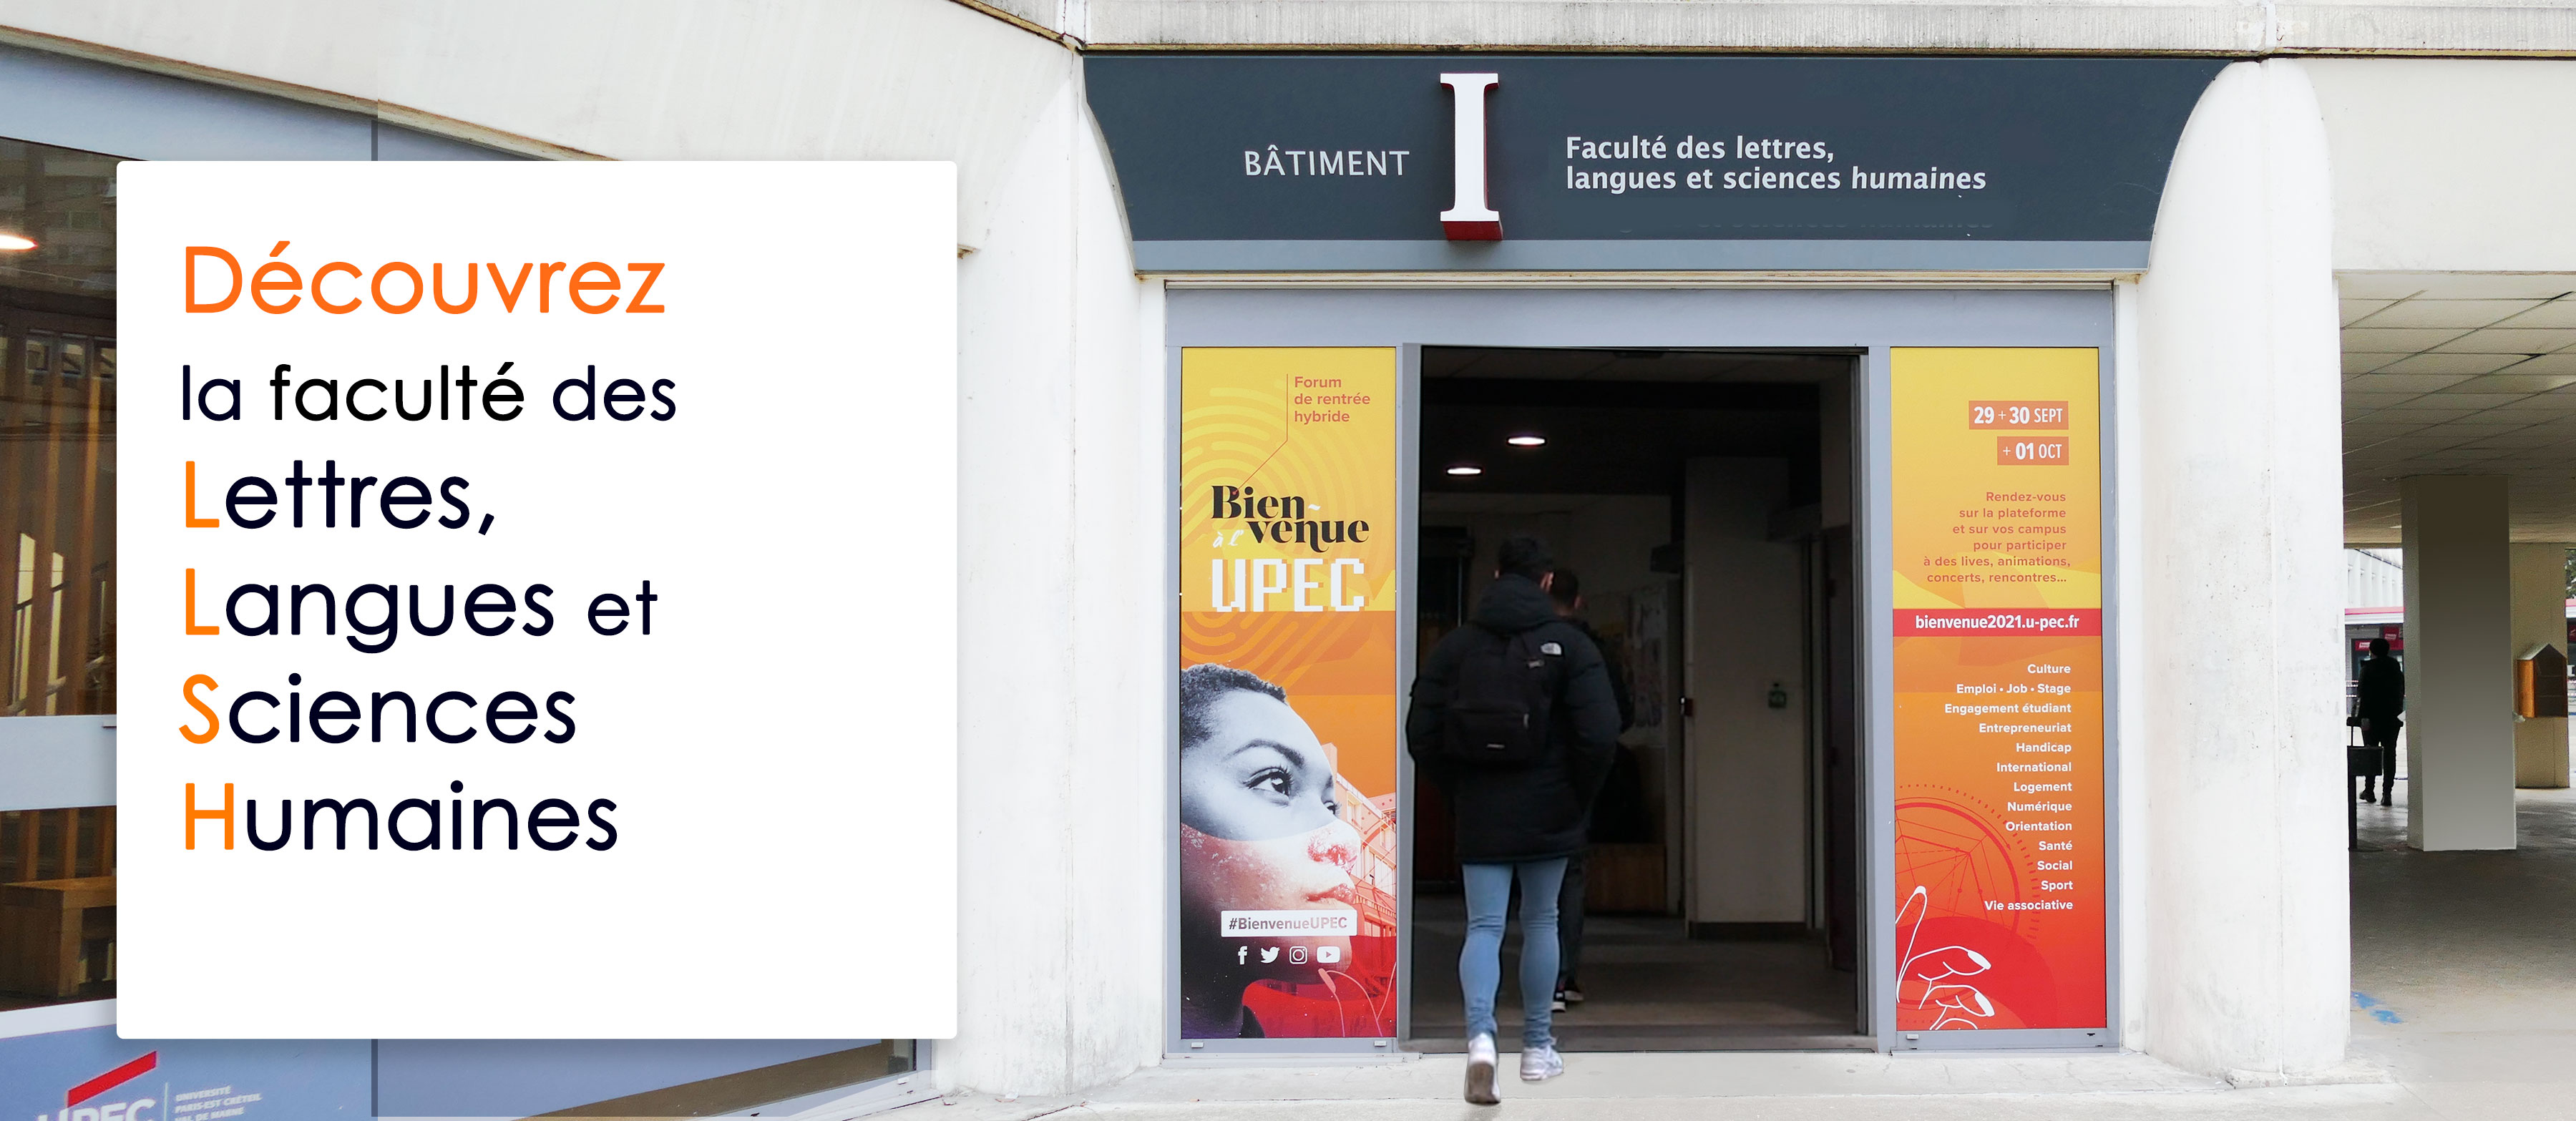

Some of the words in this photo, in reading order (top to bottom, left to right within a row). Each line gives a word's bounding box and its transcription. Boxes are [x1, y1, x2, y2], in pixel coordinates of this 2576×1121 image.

[1440, 73, 1499, 221] I
[1567, 136, 1666, 159] Faculté
[1677, 135, 1724, 158] des
[1737, 136, 1833, 162] lettres,
[1245, 145, 1409, 175] BÂTIMENT
[1568, 166, 1676, 194] langues
[1687, 170, 1712, 189] et
[1724, 167, 1840, 189] sciences
[1853, 166, 1986, 189] humaines
[1295, 376, 1341, 388] Forum
[1294, 393, 1312, 404] de
[1318, 393, 1370, 404] rentrée
[1295, 410, 1350, 425] hybride
[1974, 406, 1994, 424] 29
[2009, 406, 2029, 424] 30
[2034, 408, 2062, 422] SEPT
[2016, 443, 2034, 459] 01
[2039, 444, 2062, 458] OCT
[1986, 492, 2066, 501] Rendez-vous
[1212, 486, 1304, 520] Bien
[1984, 508, 1993, 517] la
[1999, 508, 2066, 519] plateforme
[1247, 521, 1369, 552] venue
[1953, 525, 1964, 534] et
[2019, 527, 2066, 536] campus
[1212, 532, 1224, 547] à
[1974, 542, 2001, 552] pour
[2007, 540, 2067, 552] participer
[1924, 557, 1930, 566] à
[1935, 557, 1956, 566] des
[1962, 556, 1993, 567] lives,
[1998, 556, 2070, 567] animations,
[1927, 574, 1984, 583] concerts,
[1212, 558, 1364, 612] UPEC
[1916, 615, 2079, 631] bienvenue2021.u-pec.fr
[2028, 664, 2071, 673] Culture
[1957, 683, 1996, 695] Emploi
[2006, 684, 2027, 693] Job
[2038, 683, 2071, 695] Stage
[1945, 704, 2019, 715] Engagement
[2022, 703, 2071, 713] étudiant
[1979, 723, 2072, 734] Entrepreneuriat
[2016, 743, 2072, 754] Handicap
[1997, 762, 2072, 772] International
[2014, 783, 2072, 793] Logement
[2008, 801, 2072, 813] Numérique
[2006, 821, 2072, 831] Orientation
[2039, 841, 2072, 851] Santé
[2037, 861, 2072, 870] Social
[2041, 881, 2073, 891] Sport
[1985, 901, 2004, 910] Vie
[2008, 900, 2073, 910] associative
[1229, 917, 1347, 929] #BienvenueUPEC
[38, 1099, 156, 1121] EC
